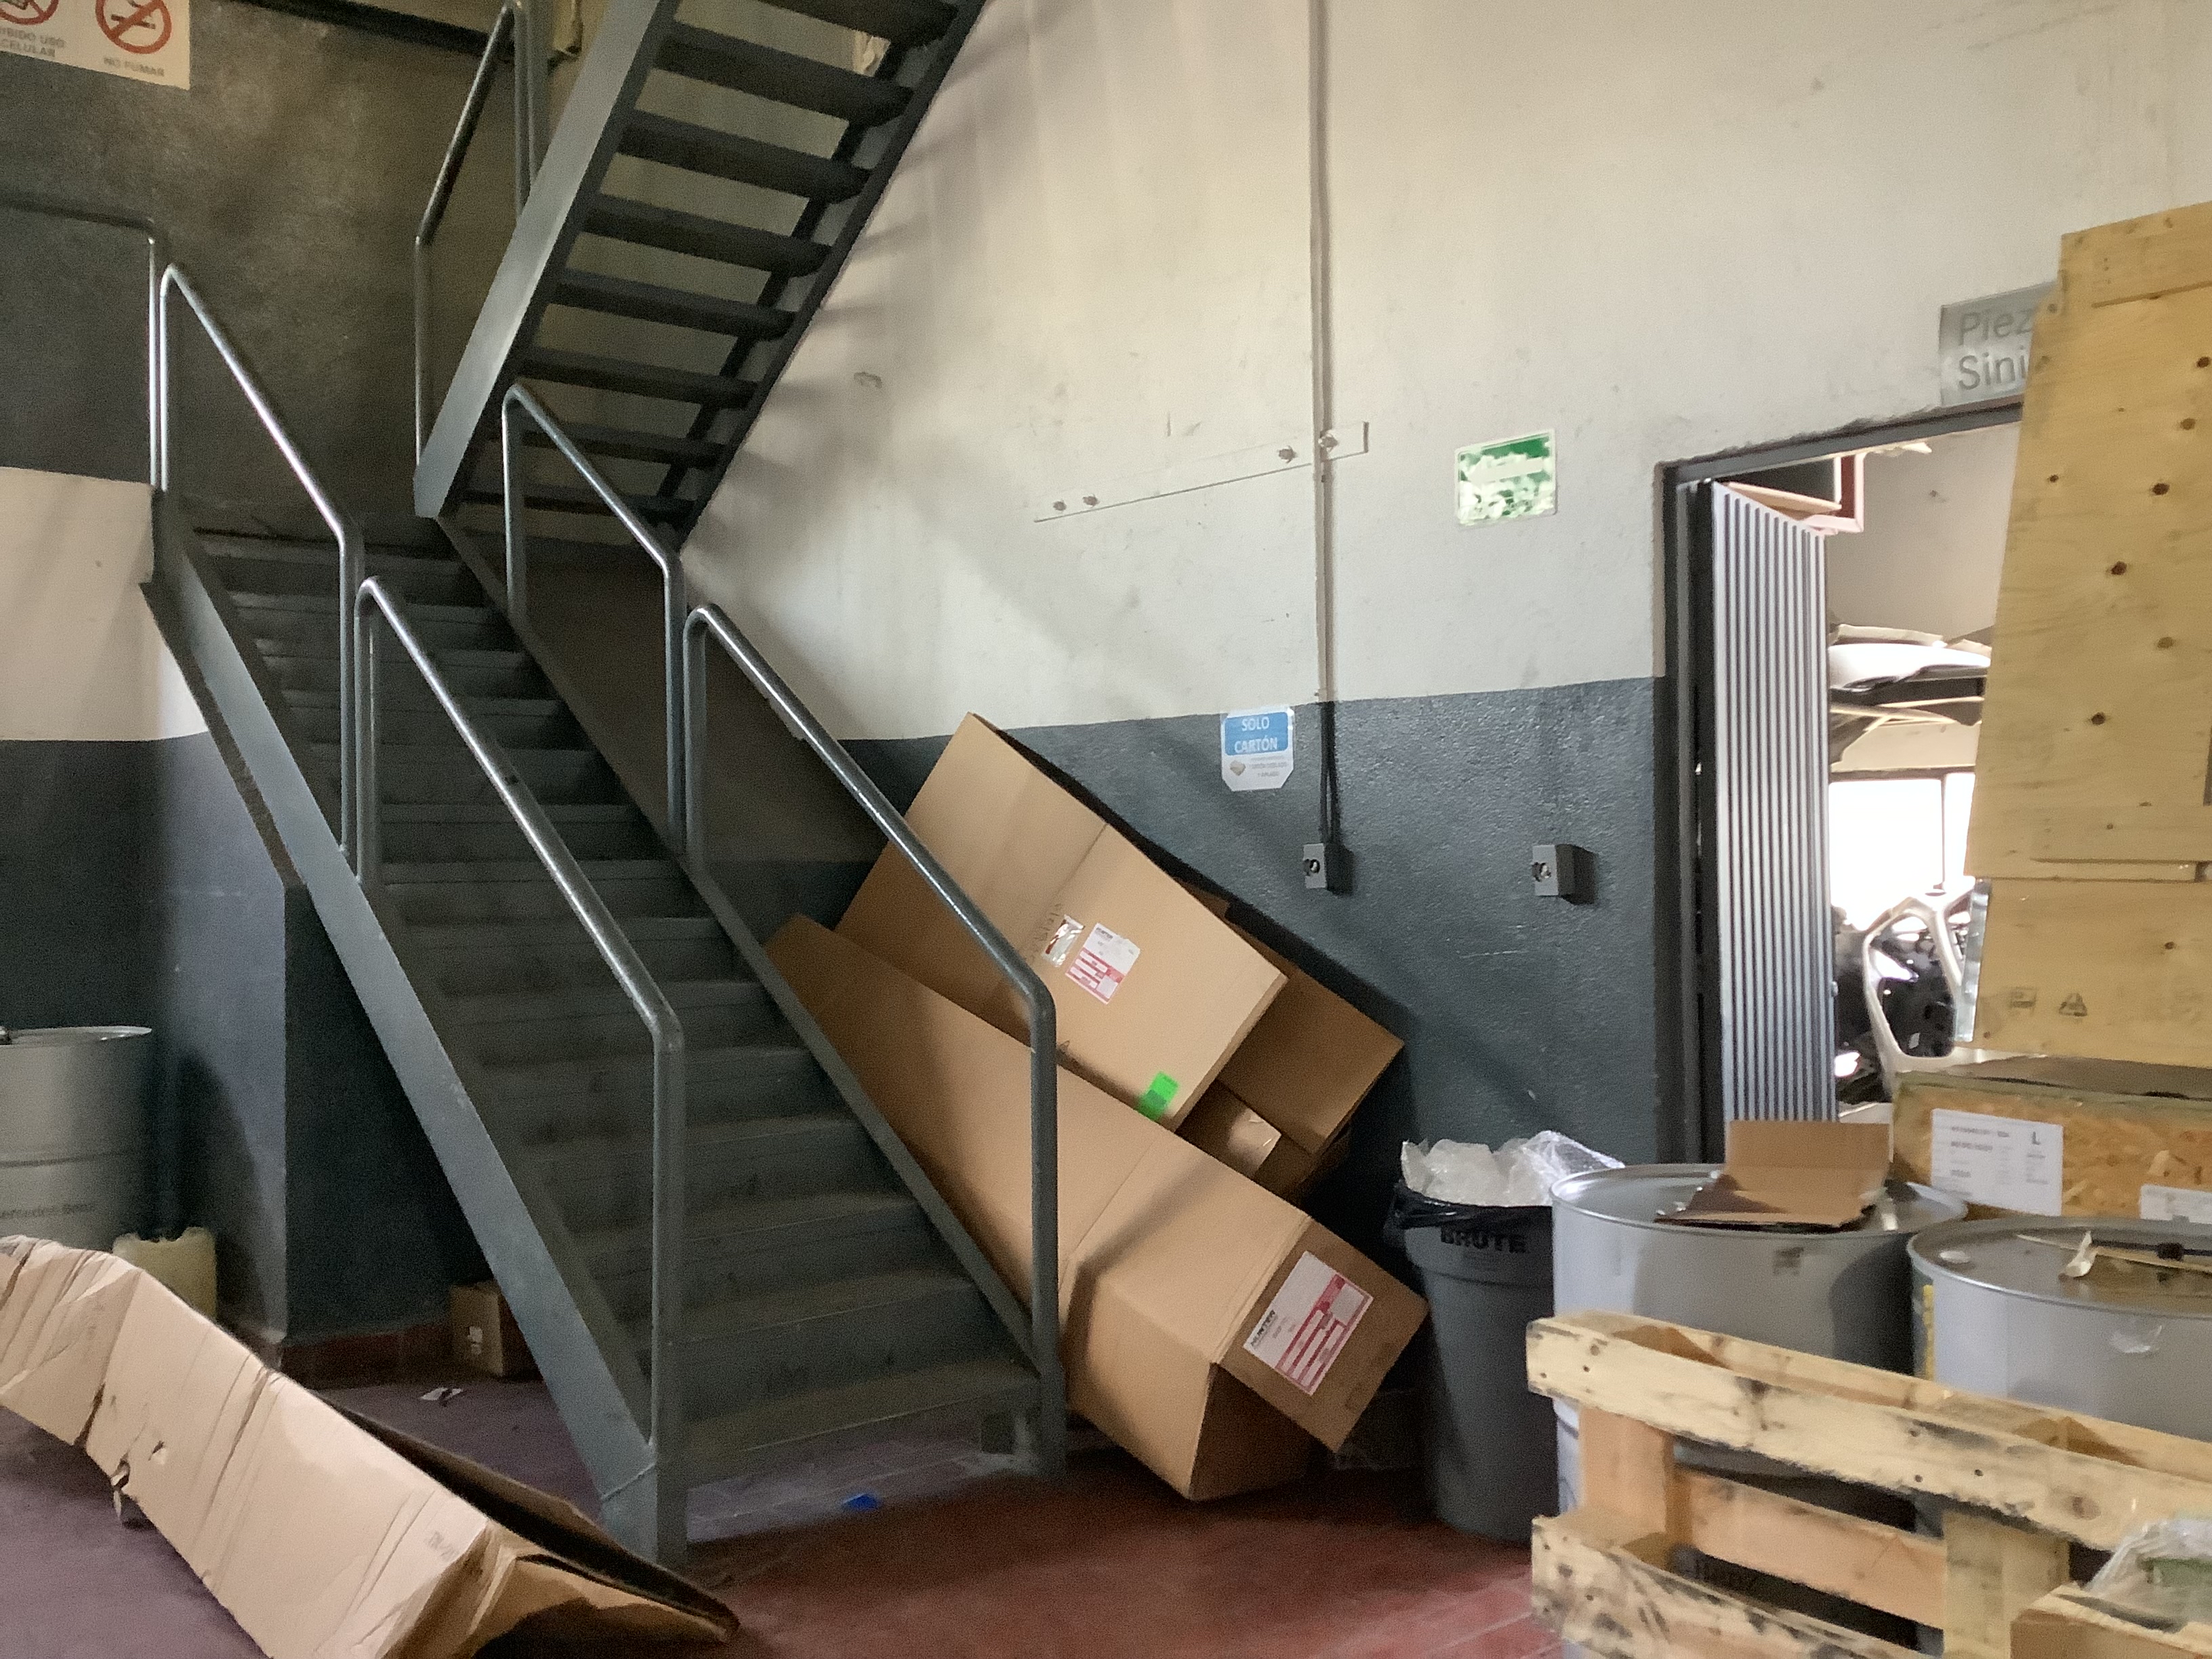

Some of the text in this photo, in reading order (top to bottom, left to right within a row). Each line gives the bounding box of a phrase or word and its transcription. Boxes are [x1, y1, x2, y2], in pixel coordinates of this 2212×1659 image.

[0, 26, 36, 41] IBIDO
[1958, 308, 2033, 346] Piez
[1959, 344, 2026, 390] Sini
[1242, 716, 1270, 732] SOLO
[1234, 735, 1278, 754] CARTÓN
[1441, 1225, 1526, 1254] BRUTE
[1250, 1309, 1276, 1347] HUNTER
